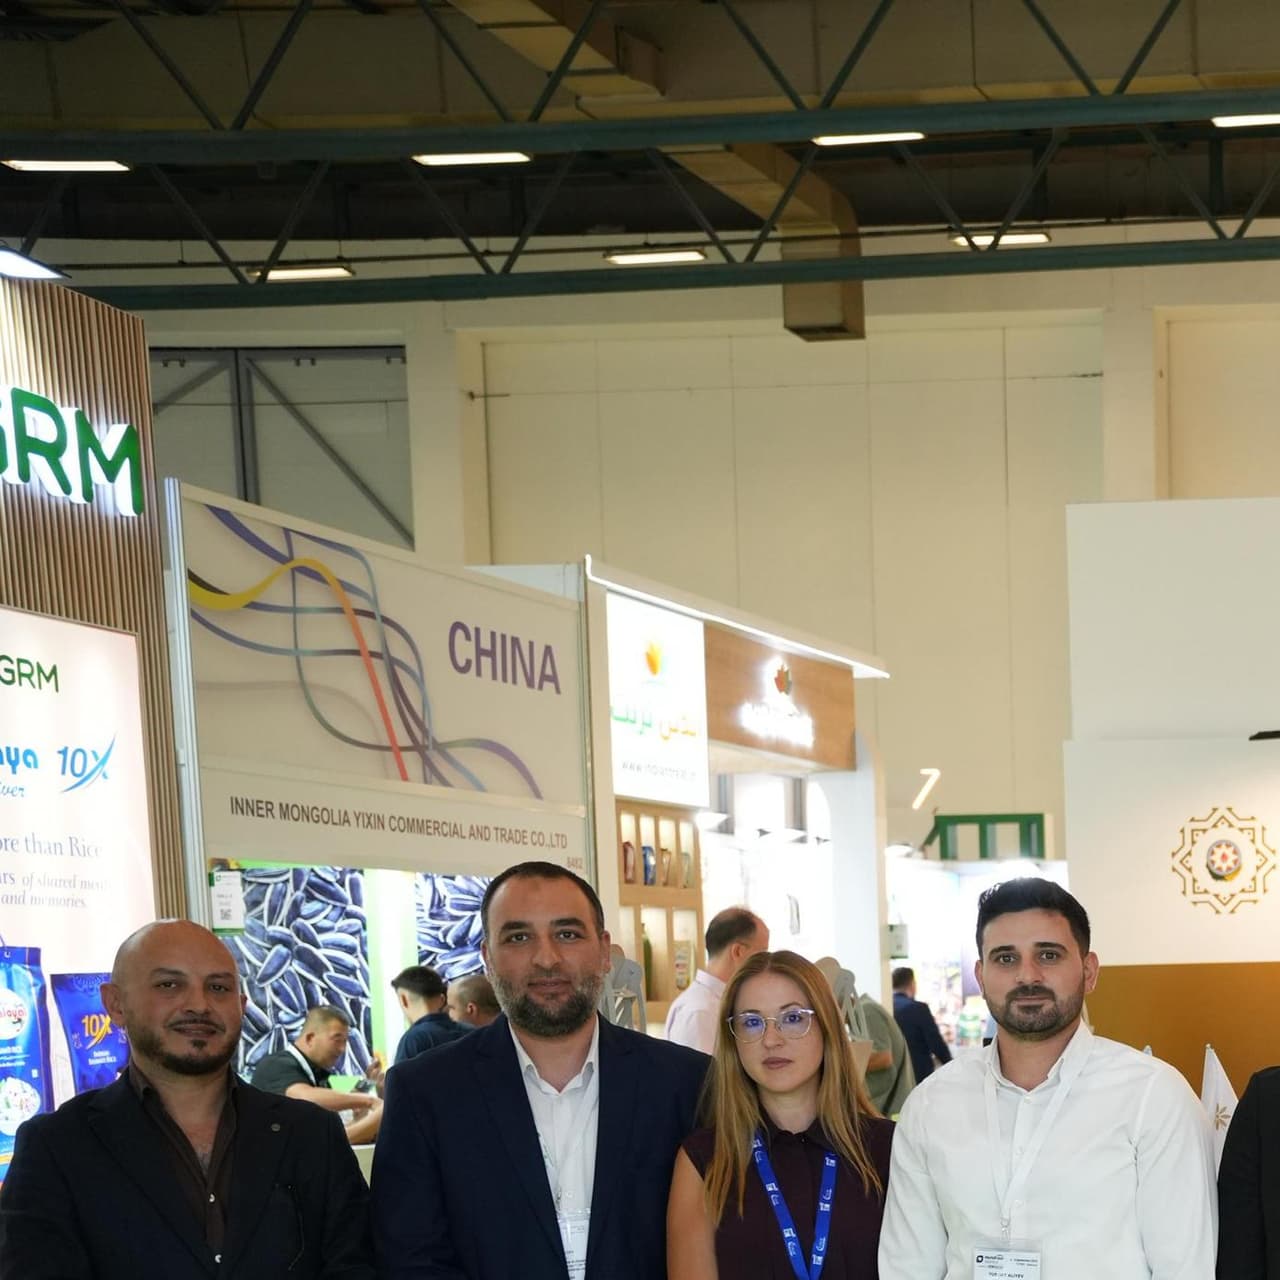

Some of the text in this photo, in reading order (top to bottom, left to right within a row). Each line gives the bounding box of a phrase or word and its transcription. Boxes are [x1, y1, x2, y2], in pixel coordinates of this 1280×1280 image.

[0, 387, 145, 516] RM
[0, 655, 59, 693] GRM
[448, 621, 562, 695] CHINA
[25, 832, 63, 856] than
[230, 796, 275, 820] INNER
[279, 803, 351, 827] MONGOLIA
[353, 812, 386, 832] YIXIN
[389, 815, 466, 840] COMMERCIAL
[468, 824, 491, 842] AND
[494, 827, 528, 846] TRADE
